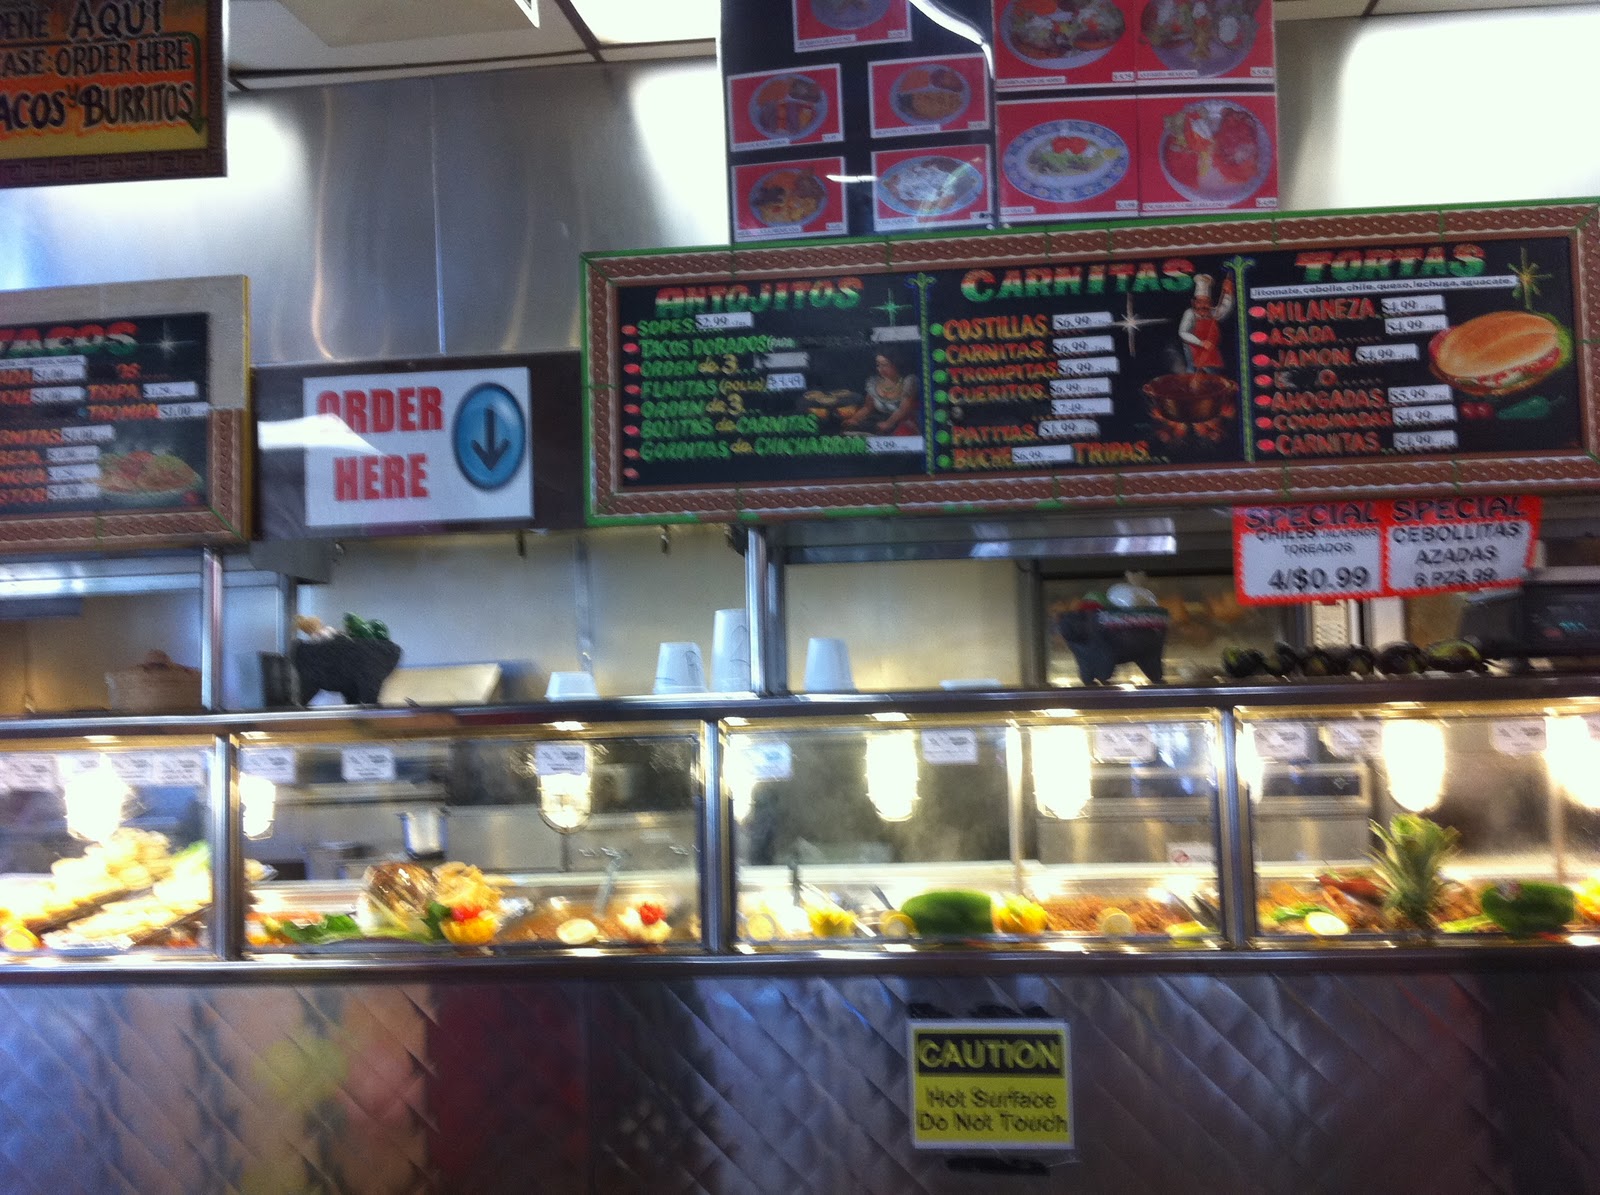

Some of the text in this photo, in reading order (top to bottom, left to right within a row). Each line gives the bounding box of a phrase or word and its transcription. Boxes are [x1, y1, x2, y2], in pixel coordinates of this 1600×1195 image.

[0, 8, 48, 40] ENE
[55, 42, 131, 76] ORDER
[137, 37, 191, 72] HERE
[79, 83, 195, 127] BURRITOS
[1294, 243, 1487, 283] TORTAS
[960, 258, 1196, 302] CARNITAS
[655, 277, 864, 318] ANTOJITOS
[1265, 298, 1377, 323] MILANEZA
[637, 319, 696, 337] SOPES
[943, 314, 1051, 342] COSTILLAS
[1268, 325, 1337, 347] ASADA
[638, 339, 690, 358] TACOS
[946, 340, 1048, 366] CARNITAS
[1272, 347, 1354, 367] JAMON
[317, 386, 444, 434] ORDER
[1271, 388, 1386, 411] AHOGADAS
[1275, 432, 1382, 456] CARNITAS
[334, 453, 430, 502] HERE
[1245, 502, 1379, 529] SPECIAL
[1391, 497, 1527, 522] SPECIAL
[1256, 526, 1316, 541] CHILES
[1392, 522, 1522, 544] CEBOLLITAS
[1283, 541, 1354, 555] TOREADOS
[1415, 545, 1499, 565] AZADAS
[1267, 566, 1370, 592] 4/$0.99
[919, 1039, 1062, 1069] CAUTION
[926, 1086, 1058, 1110] Hot Surface
[918, 1111, 1069, 1133] Do Not Touch
